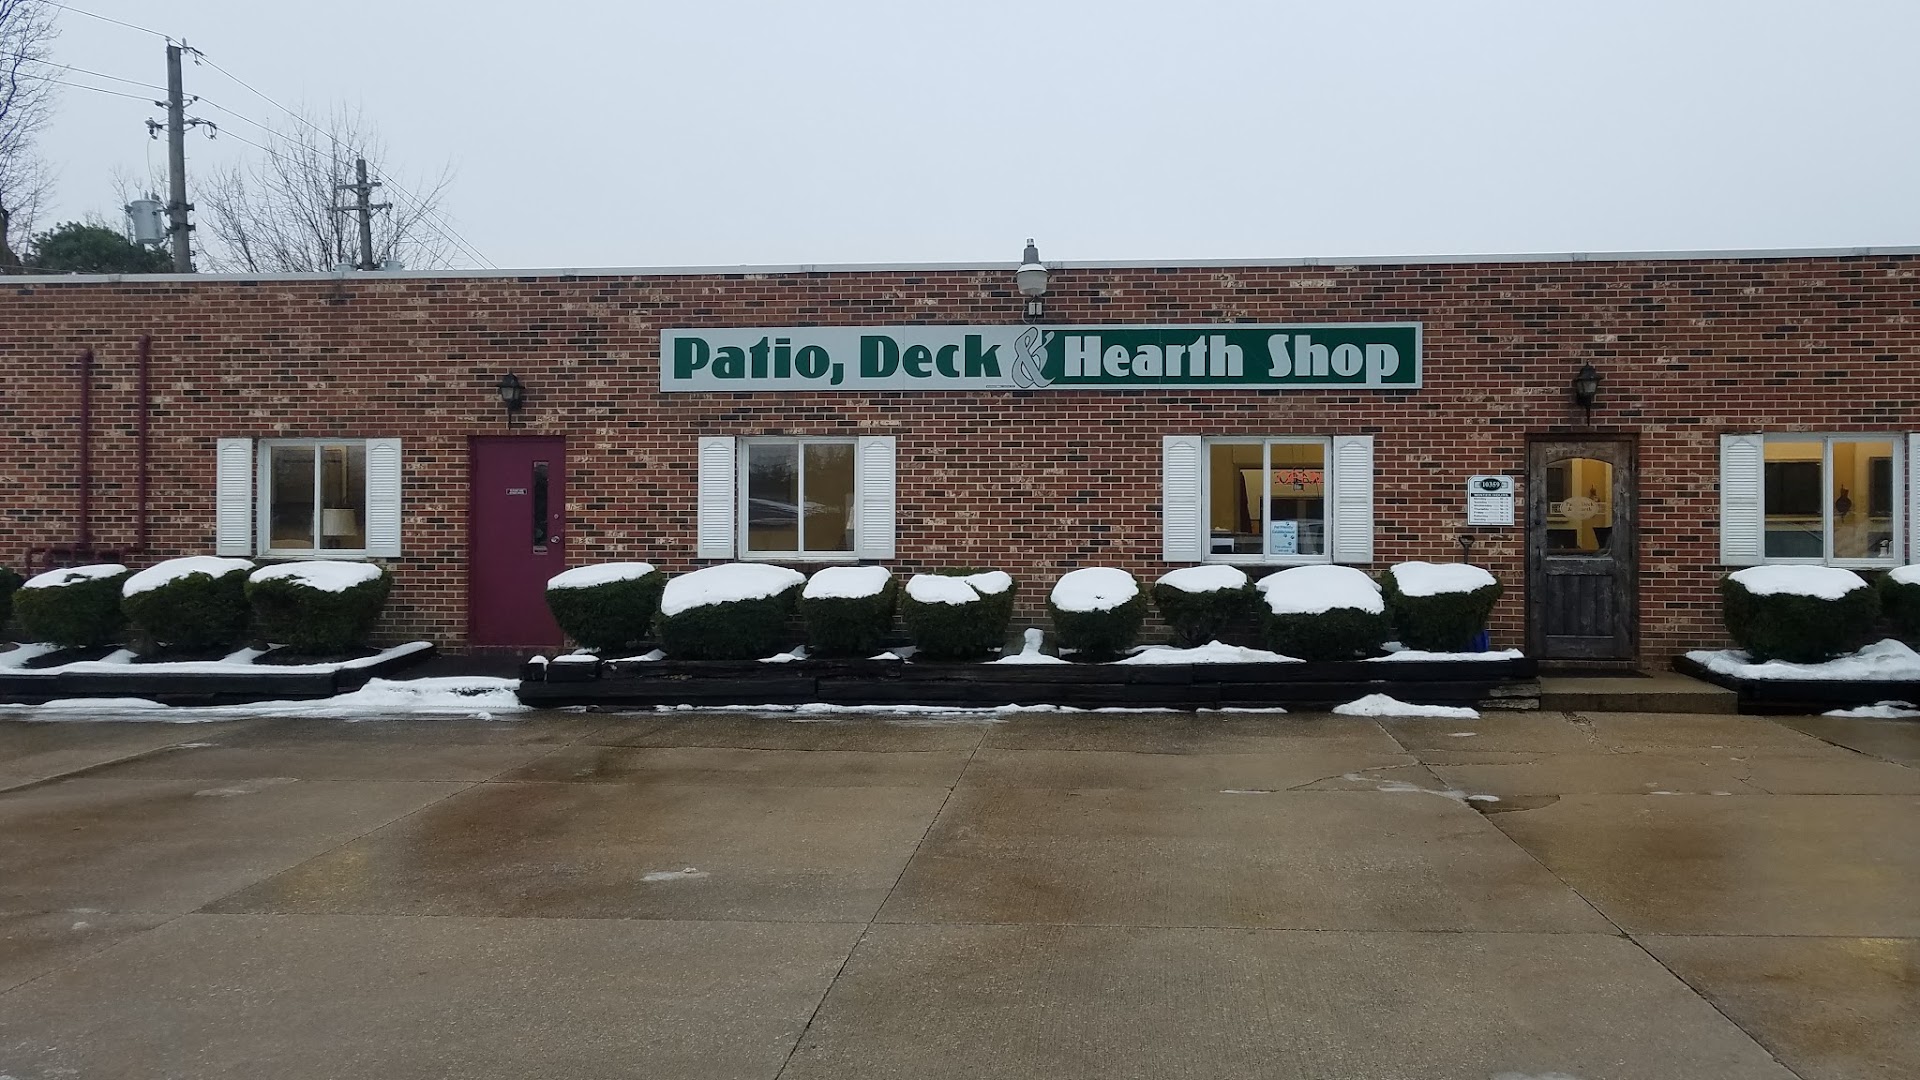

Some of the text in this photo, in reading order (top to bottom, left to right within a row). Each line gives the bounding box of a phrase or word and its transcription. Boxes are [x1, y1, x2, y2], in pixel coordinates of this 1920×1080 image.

[674, 326, 1400, 389] Patio, Deck & Hearth Shop
